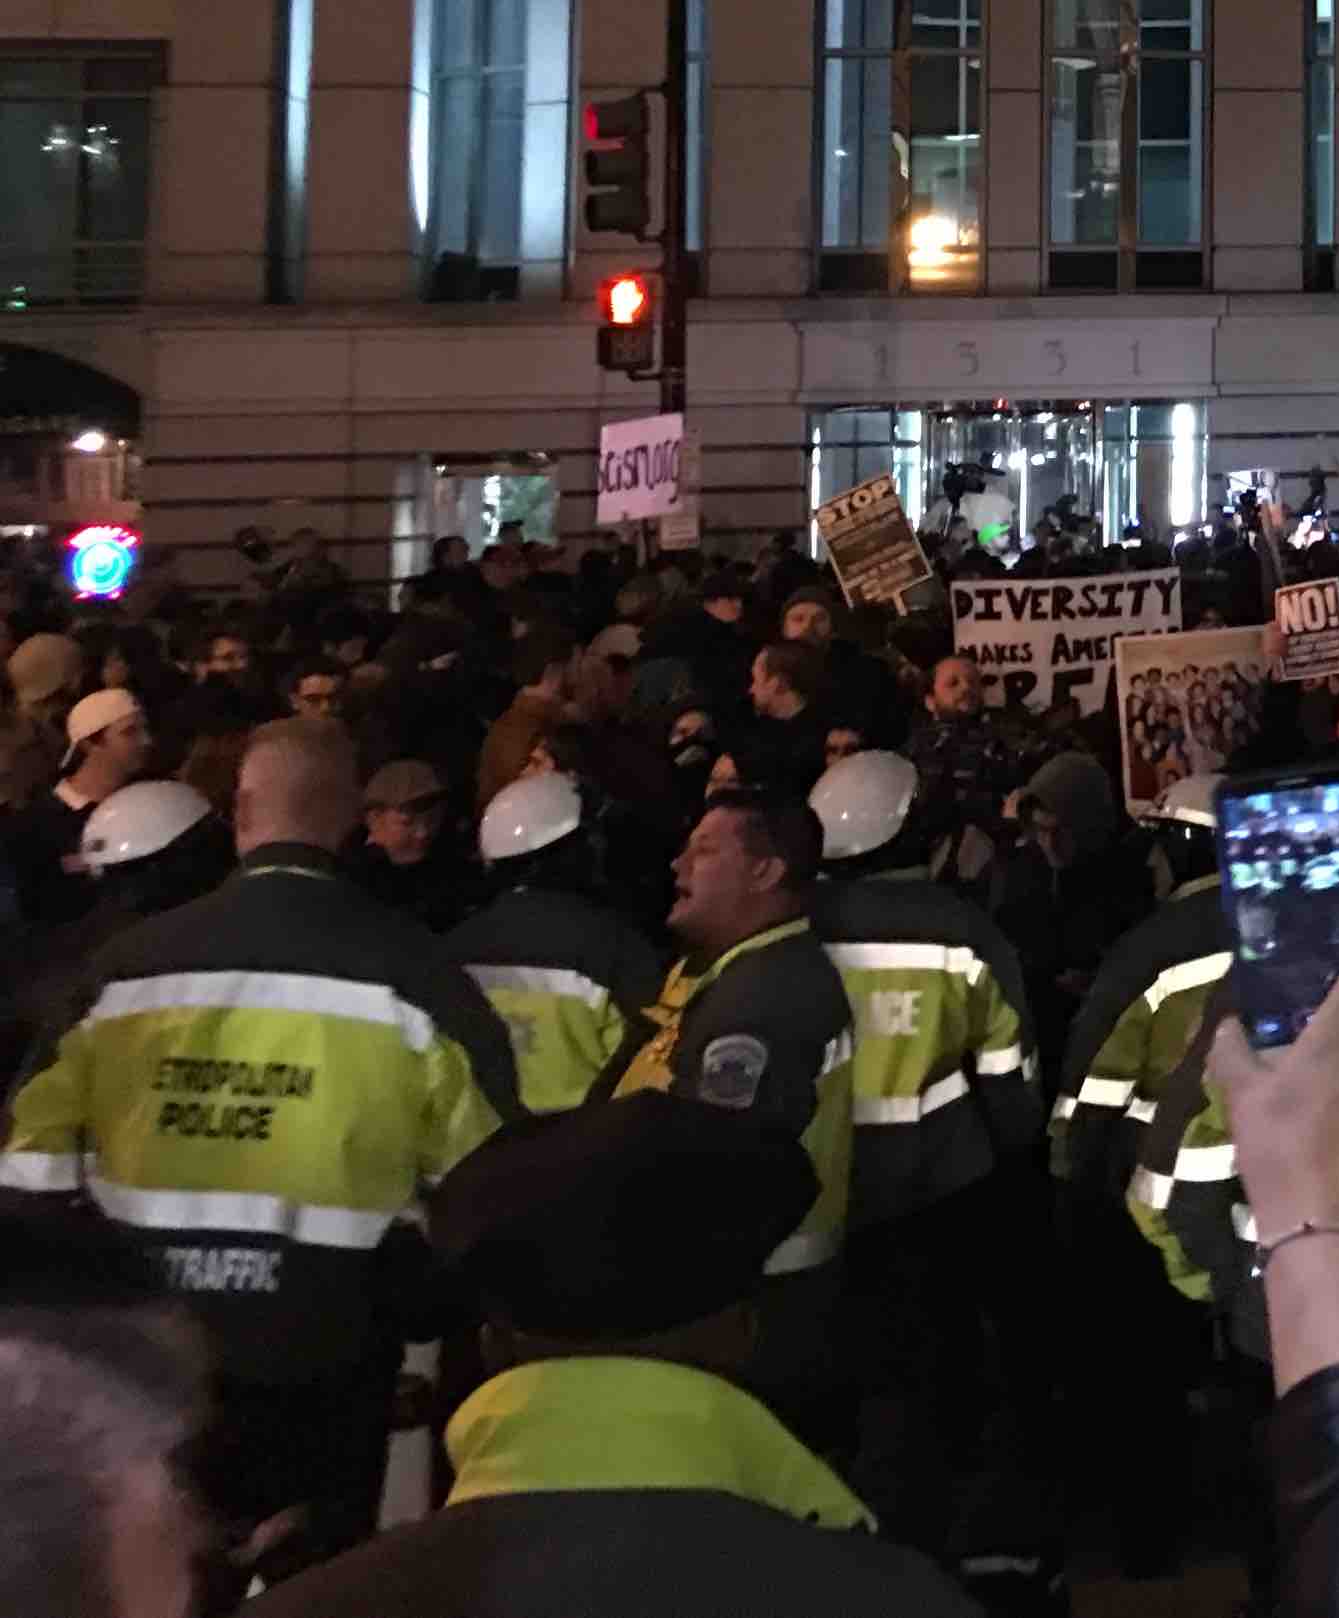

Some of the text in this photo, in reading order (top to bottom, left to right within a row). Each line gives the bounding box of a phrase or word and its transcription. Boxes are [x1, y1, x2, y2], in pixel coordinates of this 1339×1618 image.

[817, 479, 891, 534] STOP
[954, 576, 1179, 621] DIVERSITY
[1280, 584, 1339, 635] NO!
[158, 1101, 276, 1141] POLICE
[164, 1247, 282, 1293] TRAFFIC
